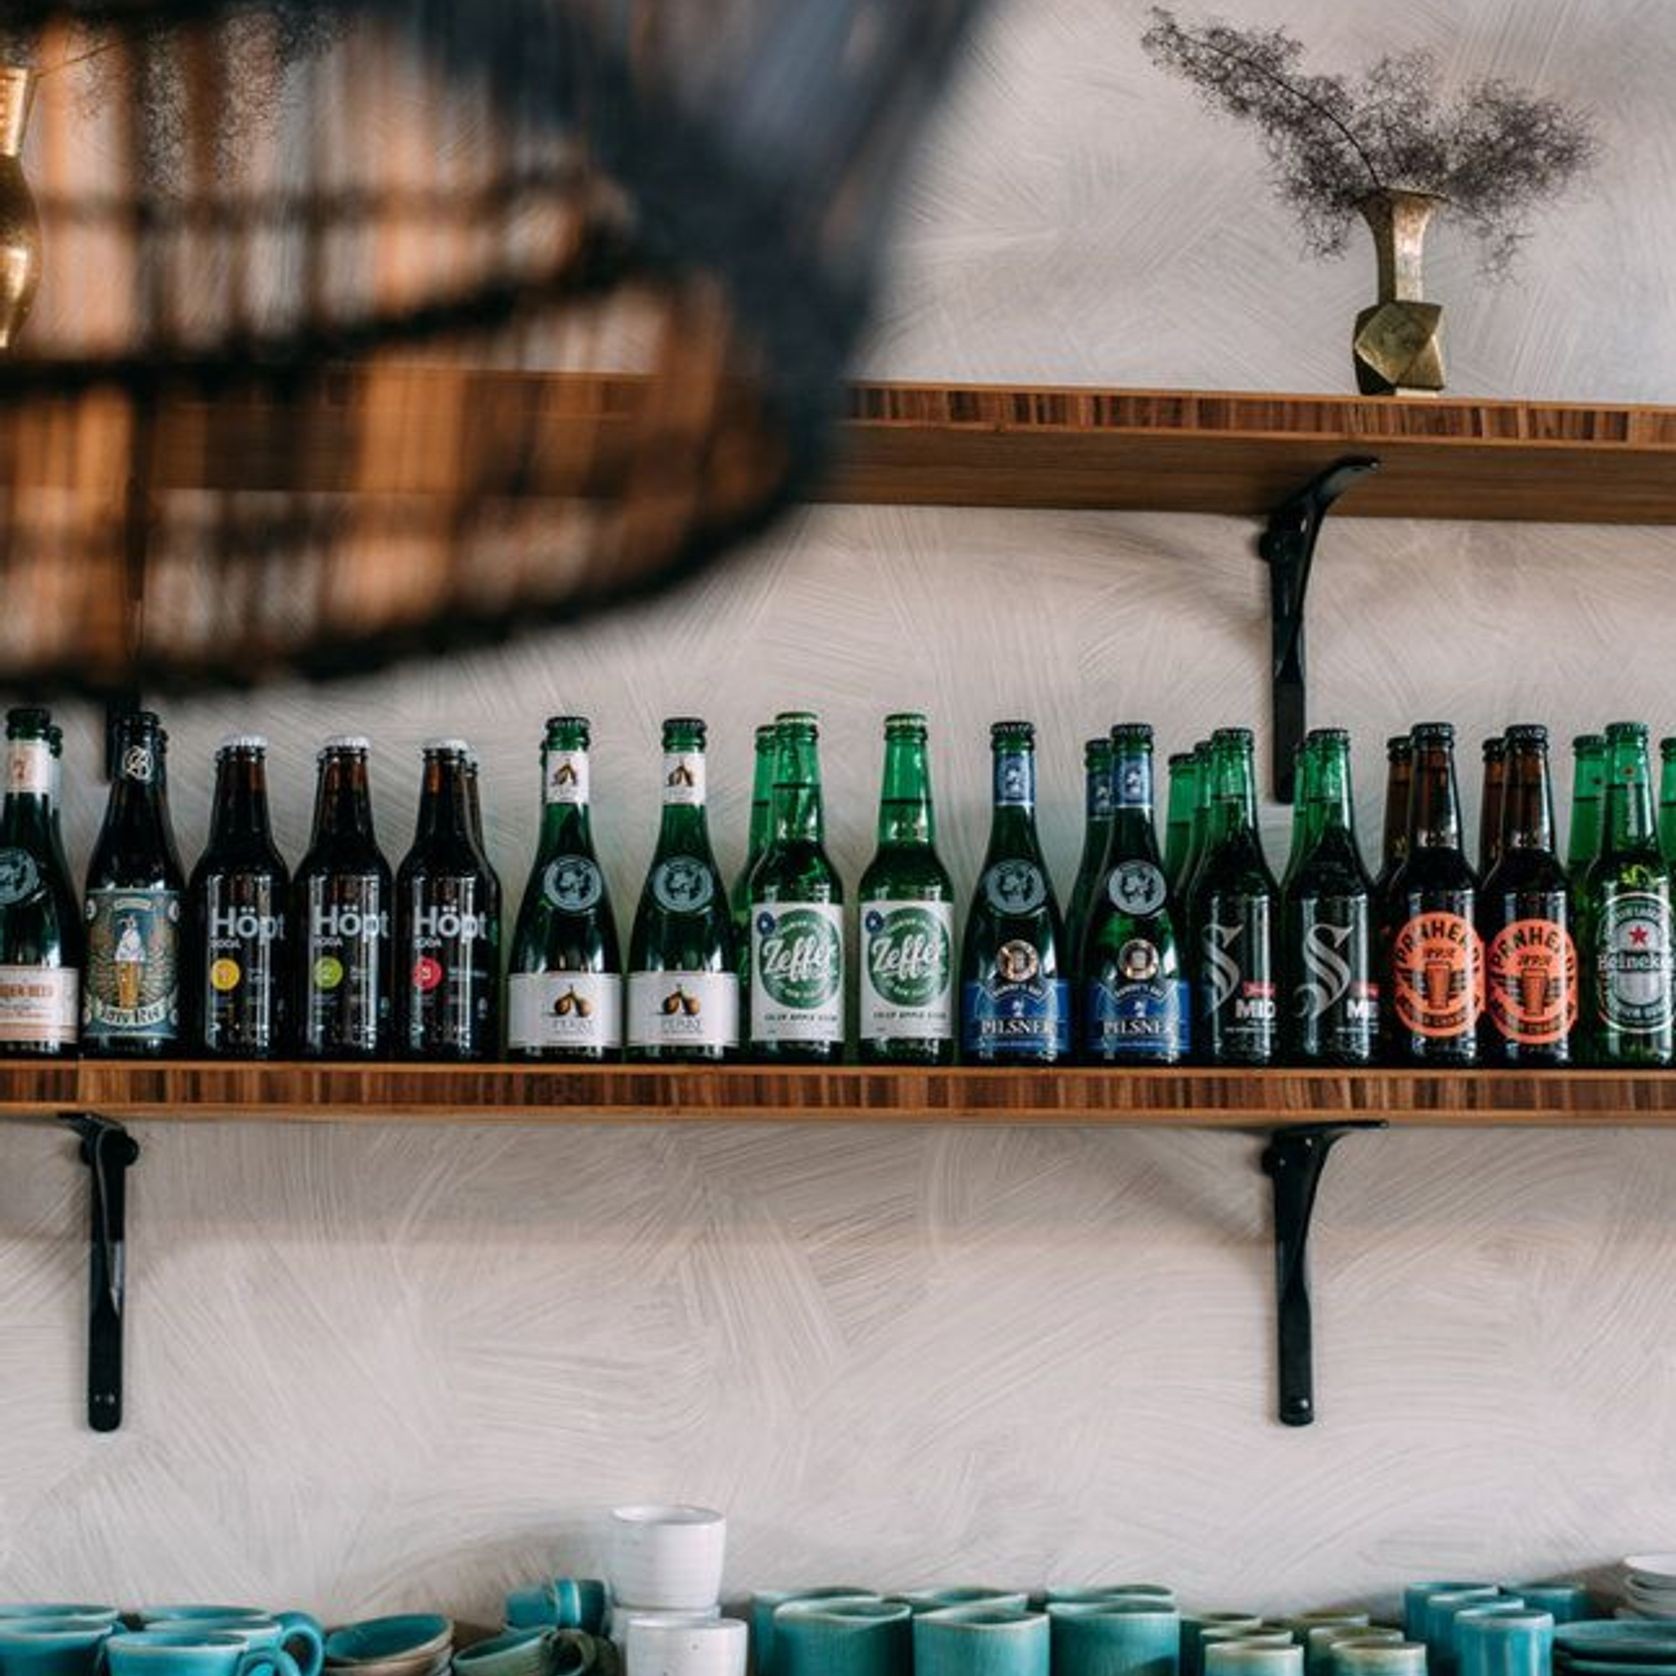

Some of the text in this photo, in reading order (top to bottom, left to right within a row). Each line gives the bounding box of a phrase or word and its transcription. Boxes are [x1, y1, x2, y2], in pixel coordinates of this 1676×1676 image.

[212, 905, 285, 945] Höpt
[315, 905, 389, 943] Höpt
[414, 905, 487, 944] Höpt
